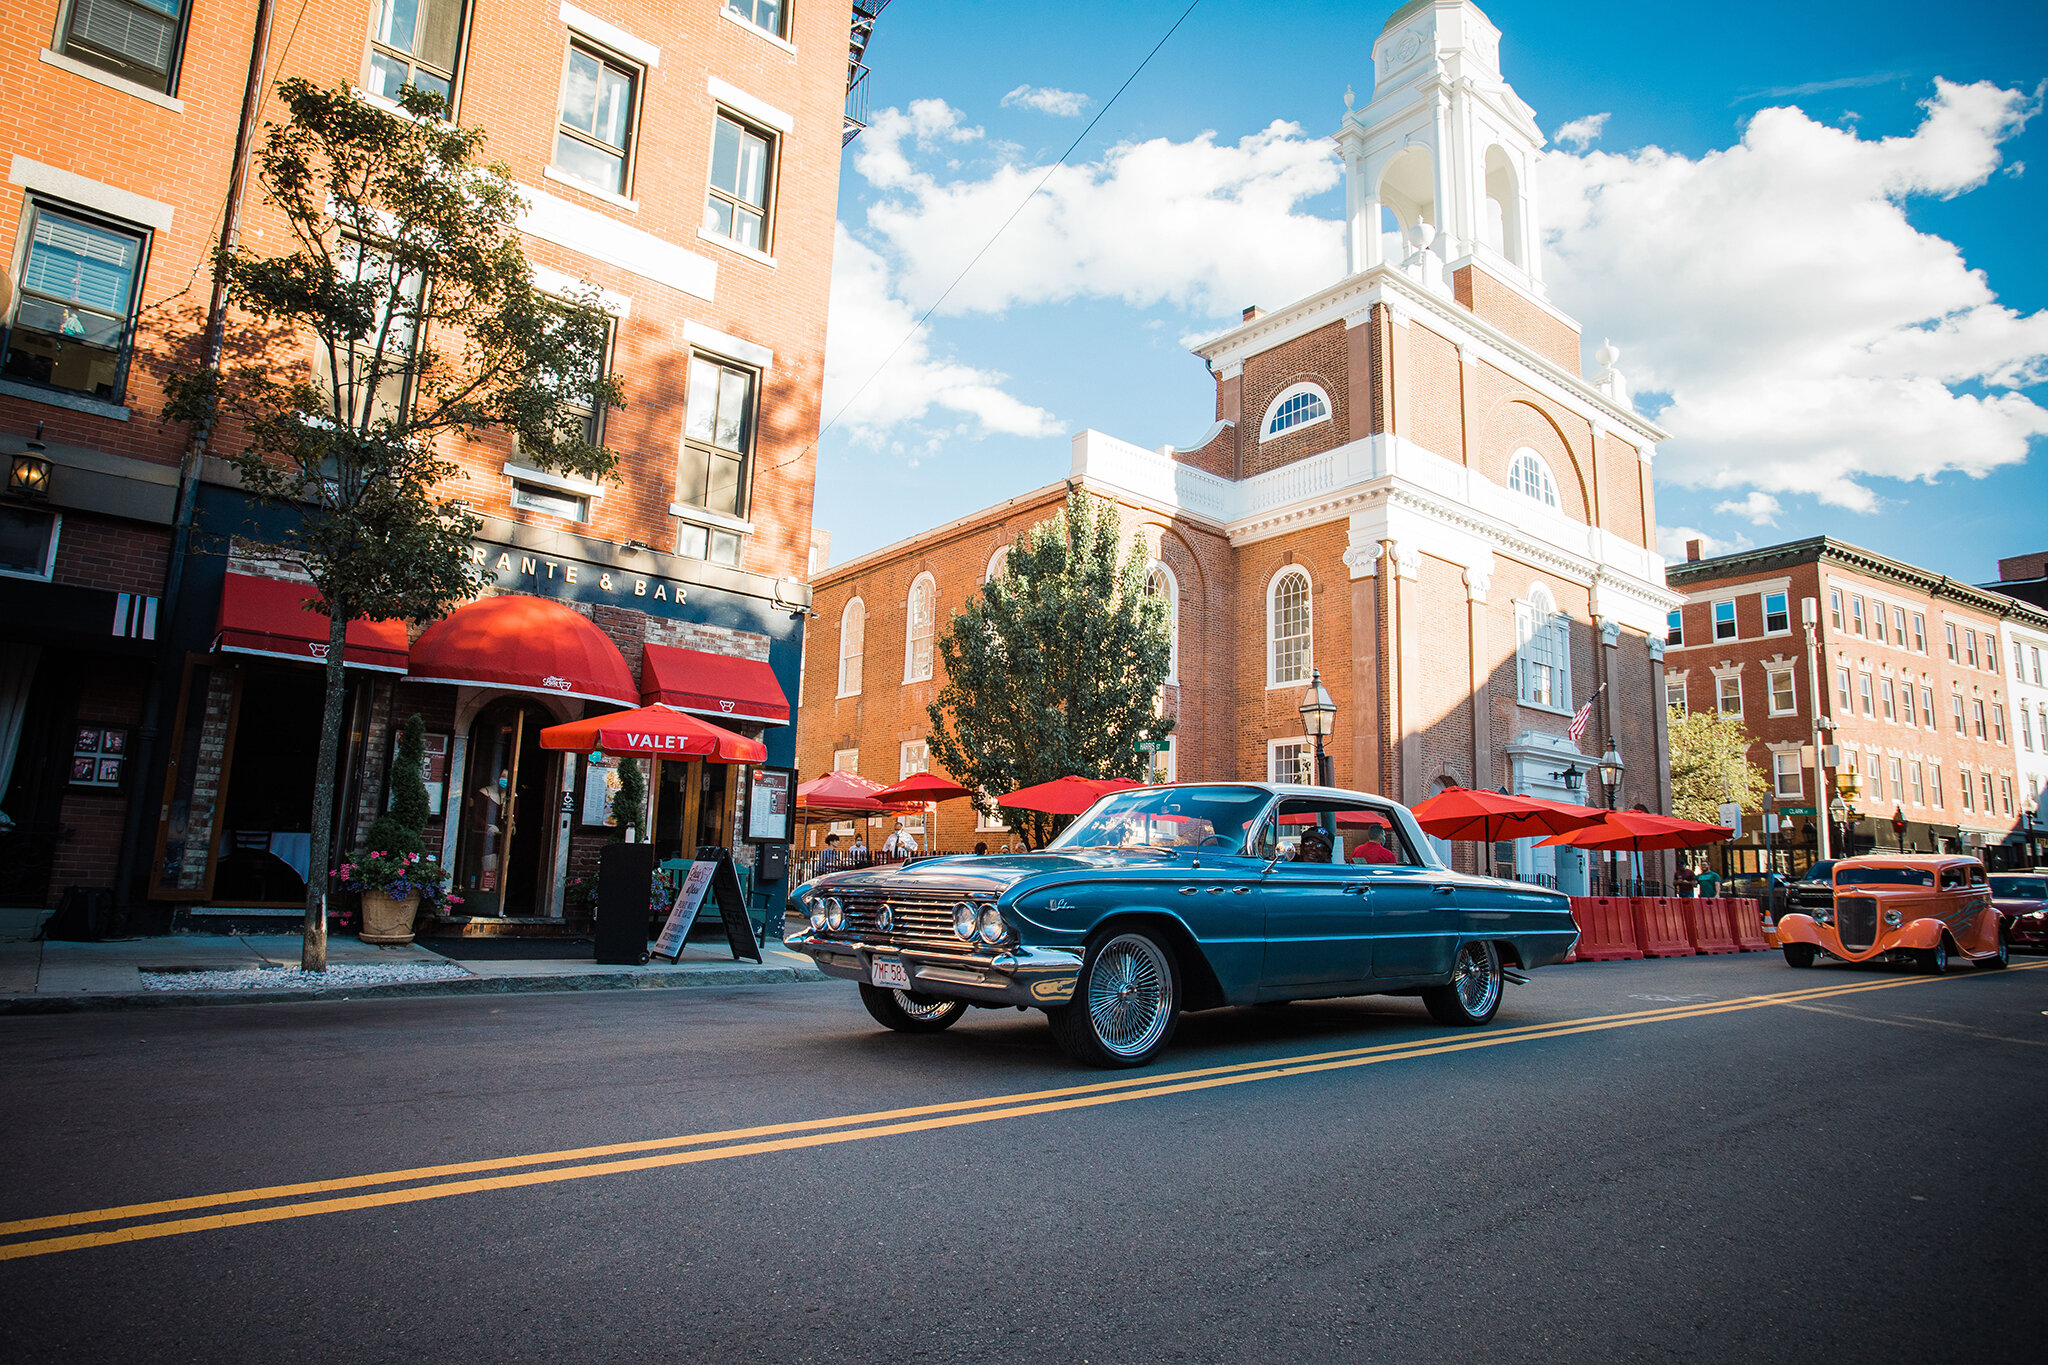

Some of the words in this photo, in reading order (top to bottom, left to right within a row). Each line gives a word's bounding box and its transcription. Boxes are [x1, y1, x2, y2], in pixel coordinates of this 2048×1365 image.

[471, 546, 578, 585] RANTE
[599, 572, 613, 591] &
[634, 579, 688, 605] BAR
[626, 733, 688, 749] VALET
[874, 962, 889, 980] 7MF
